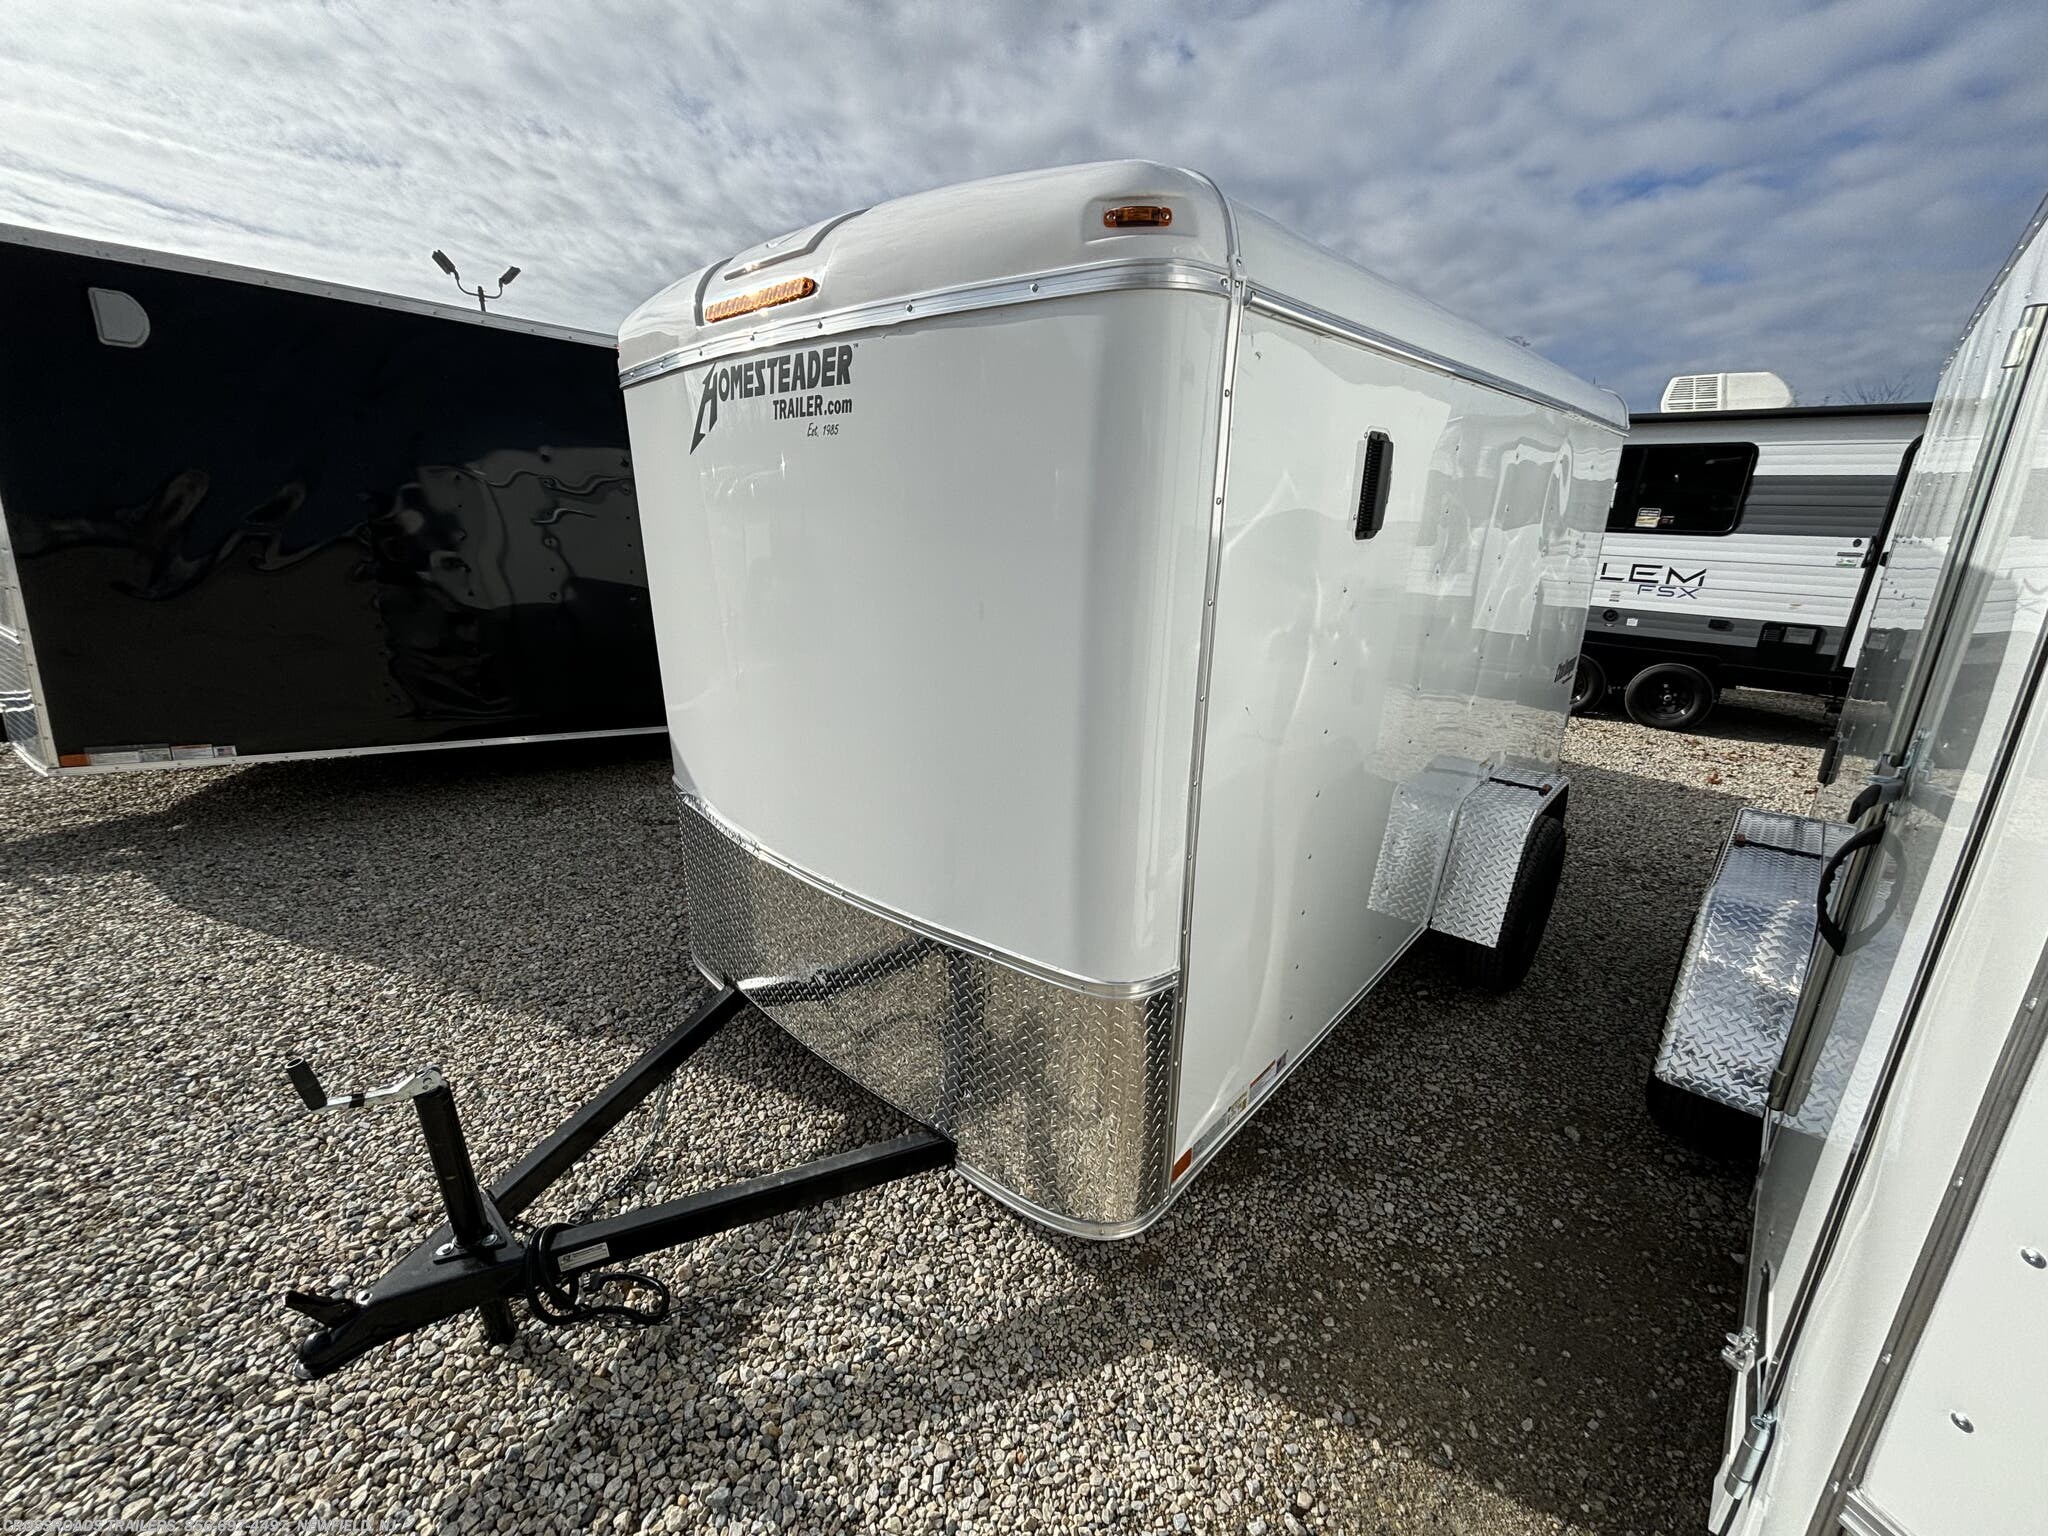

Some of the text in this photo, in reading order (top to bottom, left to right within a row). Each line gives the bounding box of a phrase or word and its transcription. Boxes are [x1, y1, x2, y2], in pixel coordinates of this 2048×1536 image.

[690, 344, 853, 455] HOMESTEADER
[773, 394, 853, 420] TRAILER.com
[822, 423, 839, 436] 1985
[1599, 562, 1707, 587] LEM
[1637, 584, 1701, 600] FSX
